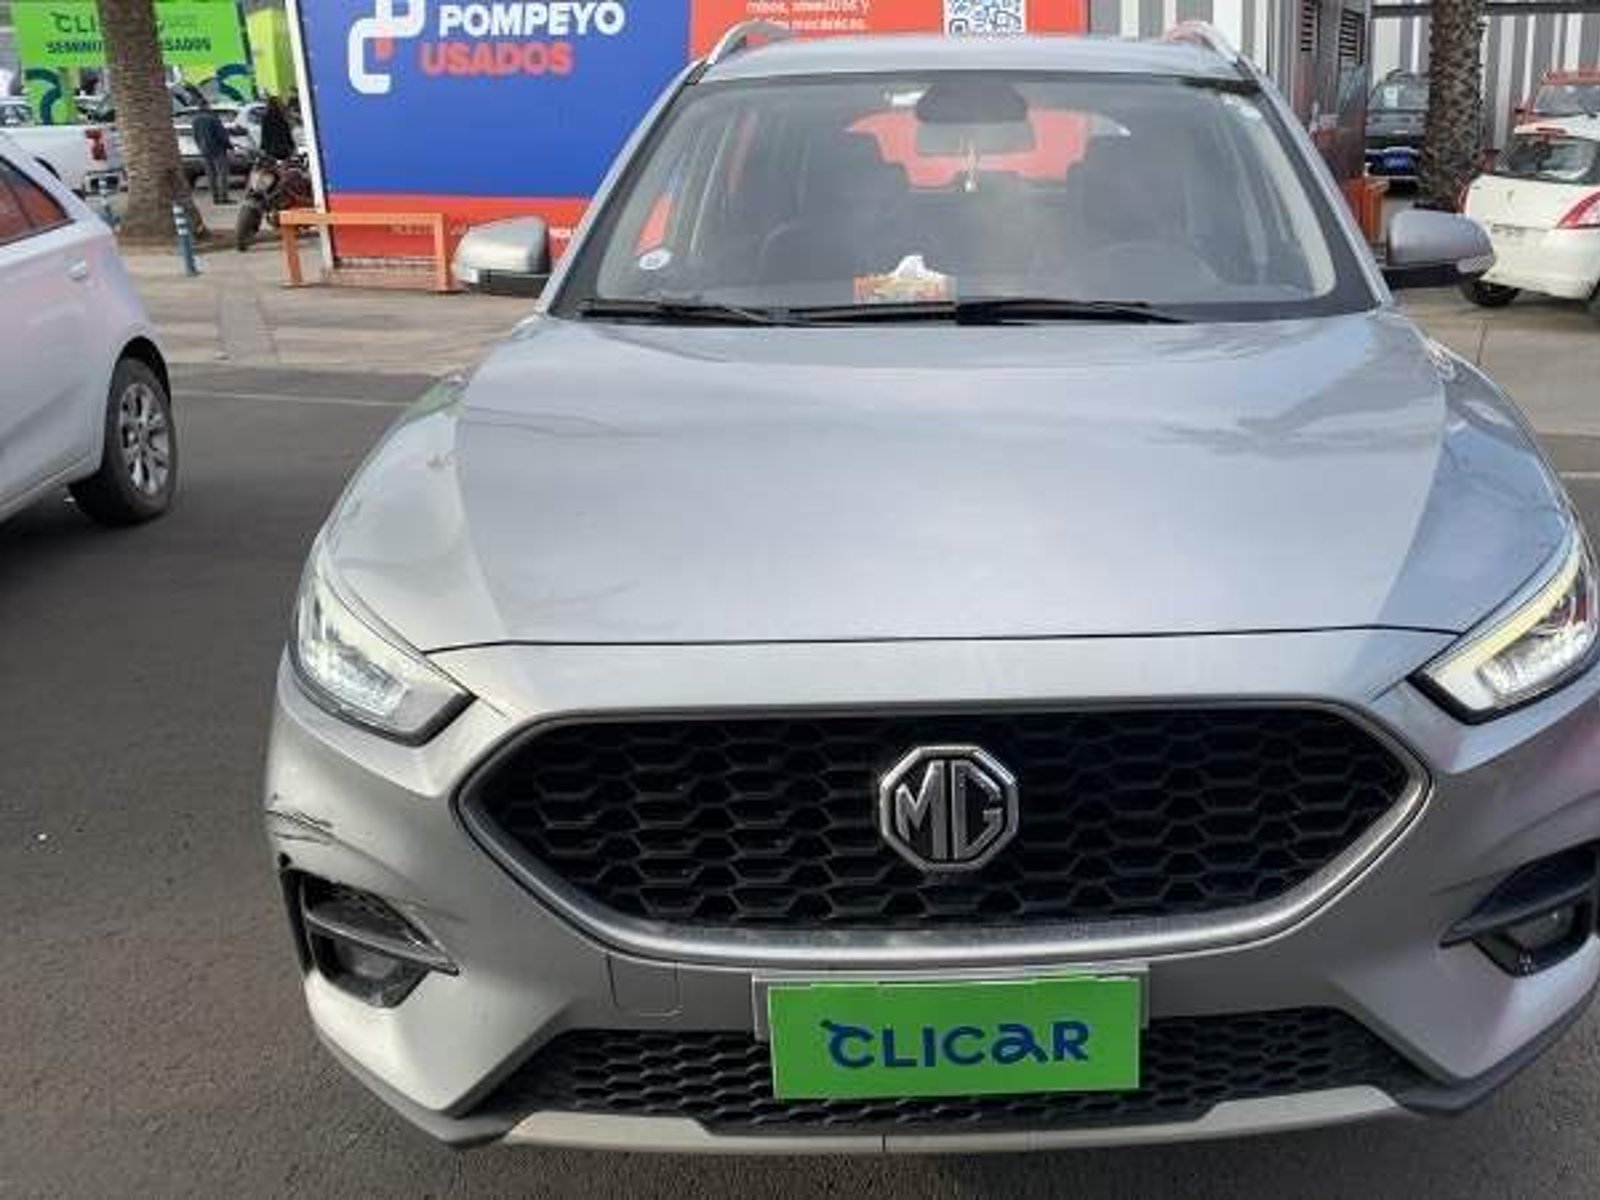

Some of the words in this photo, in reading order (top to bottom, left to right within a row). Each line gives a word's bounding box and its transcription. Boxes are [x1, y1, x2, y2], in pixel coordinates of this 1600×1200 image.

[50, 12, 97, 32] CLI
[439, 1, 625, 37] POMPEYO
[421, 41, 573, 76] USADOS
[895, 759, 1003, 861] MG
